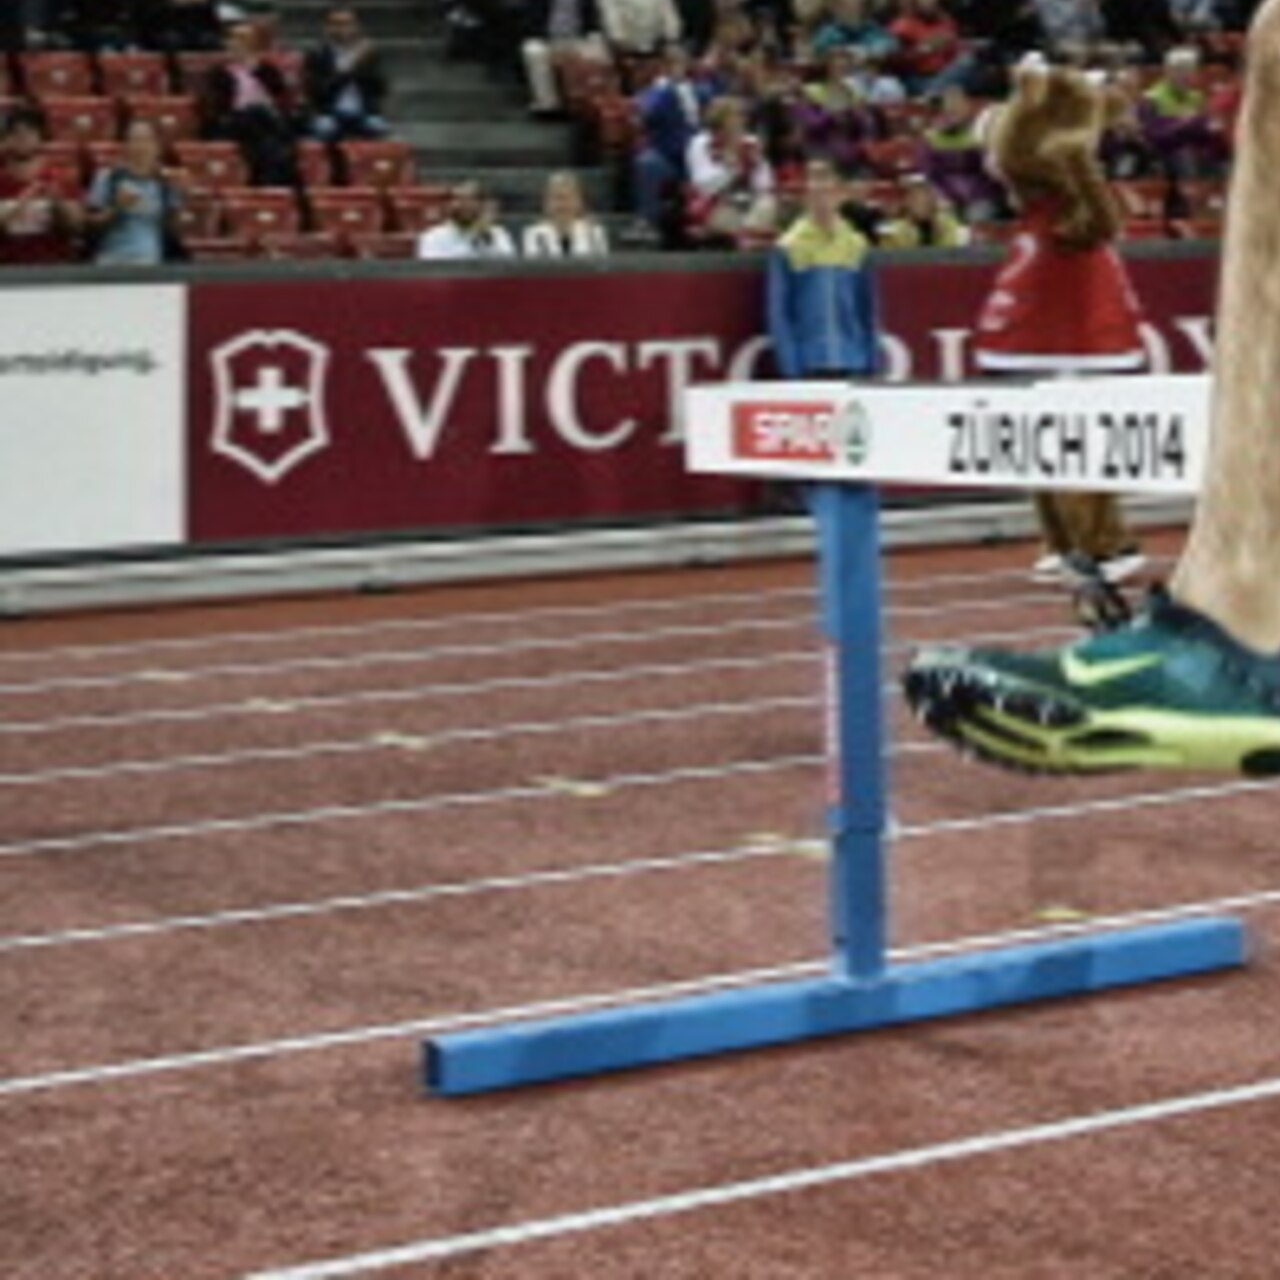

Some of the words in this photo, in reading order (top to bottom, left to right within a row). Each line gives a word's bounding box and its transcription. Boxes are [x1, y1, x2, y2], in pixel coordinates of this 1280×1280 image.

[752, 409, 836, 458] SPAR
[947, 398, 1087, 477] ZÜRICH
[1098, 414, 1187, 479] 2014
